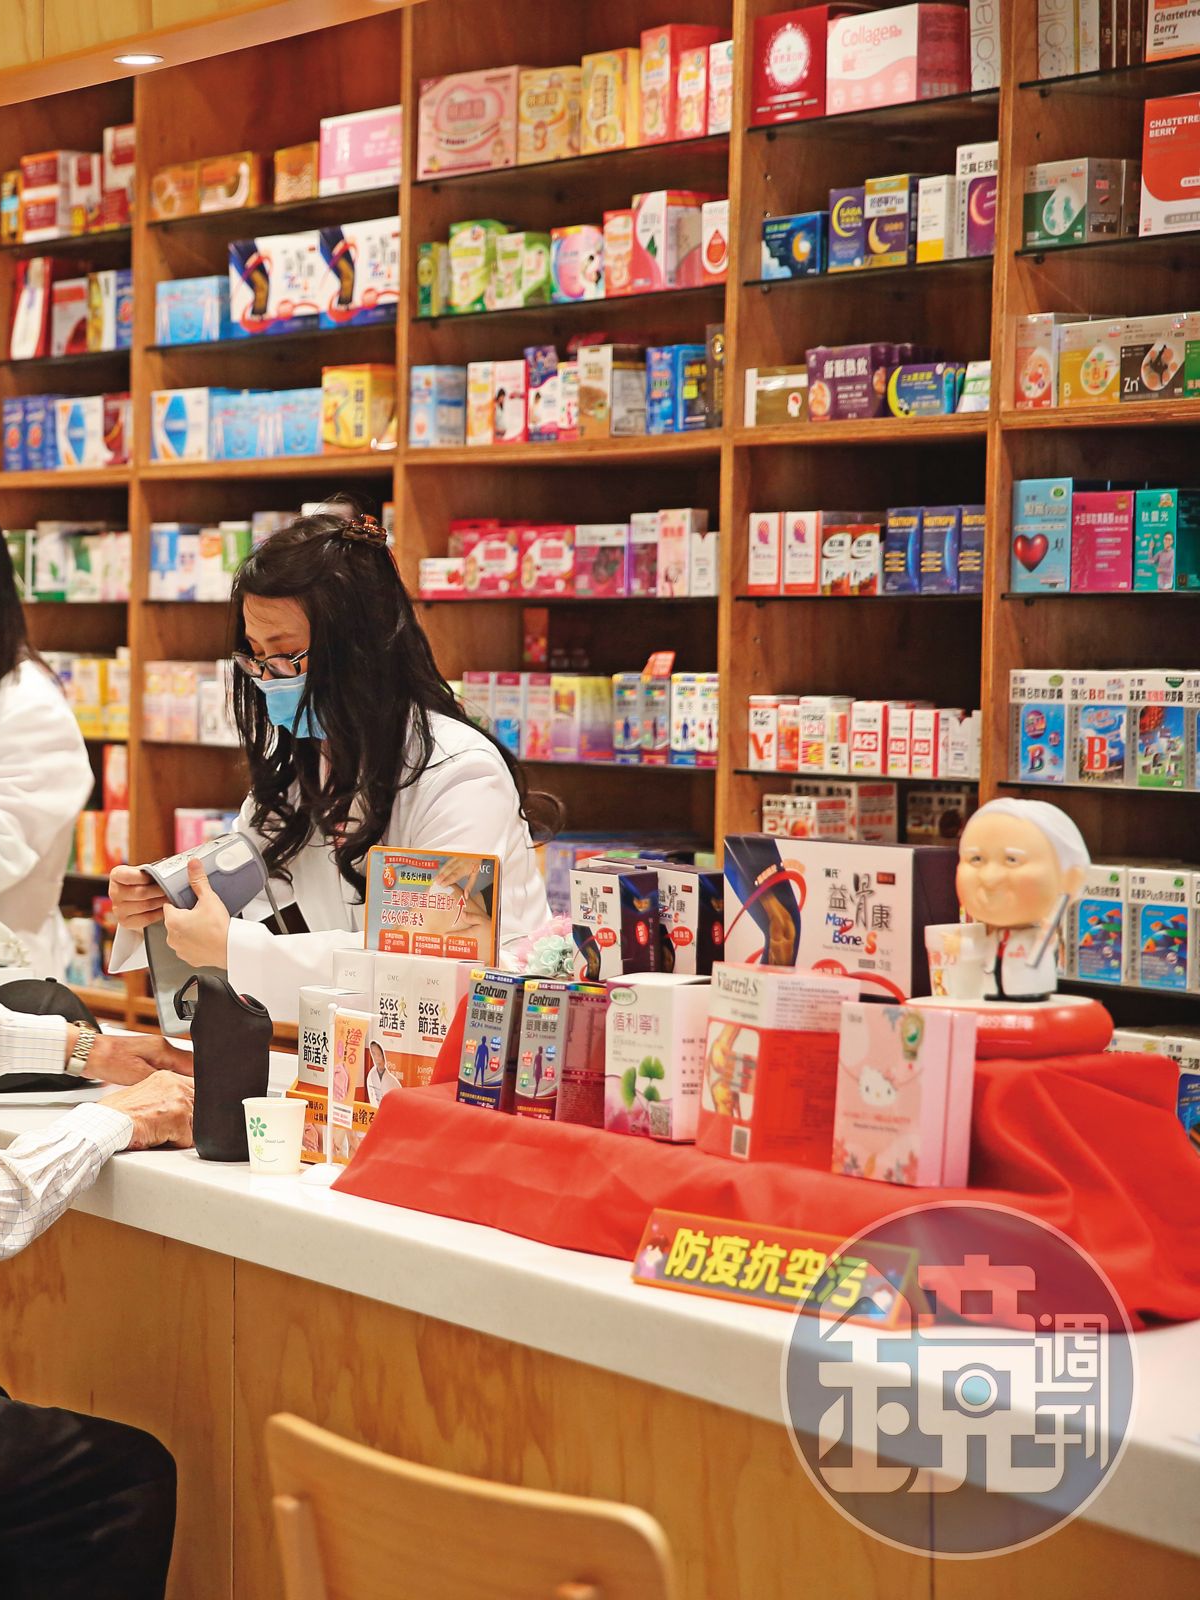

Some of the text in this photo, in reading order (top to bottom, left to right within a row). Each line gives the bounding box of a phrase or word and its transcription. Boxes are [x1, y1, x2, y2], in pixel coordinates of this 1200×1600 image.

[1153, 23, 1177, 36] Berry
[1149, 126, 1177, 138] BERRY
[1028, 745, 1046, 773] B
[1083, 736, 1109, 772] B
[825, 912, 847, 927] Max
[474, 982, 508, 999] Centrum
[379, 997, 399, 1010] らくらく
[528, 993, 560, 1007] Centrum
[418, 1001, 439, 1015] らくらく
[417, 1017, 447, 1036] 節活き
[303, 1031, 321, 1044] らくらく
[303, 1045, 328, 1065] 節活き
[664, 1227, 870, 1308] 防疫抗空污
